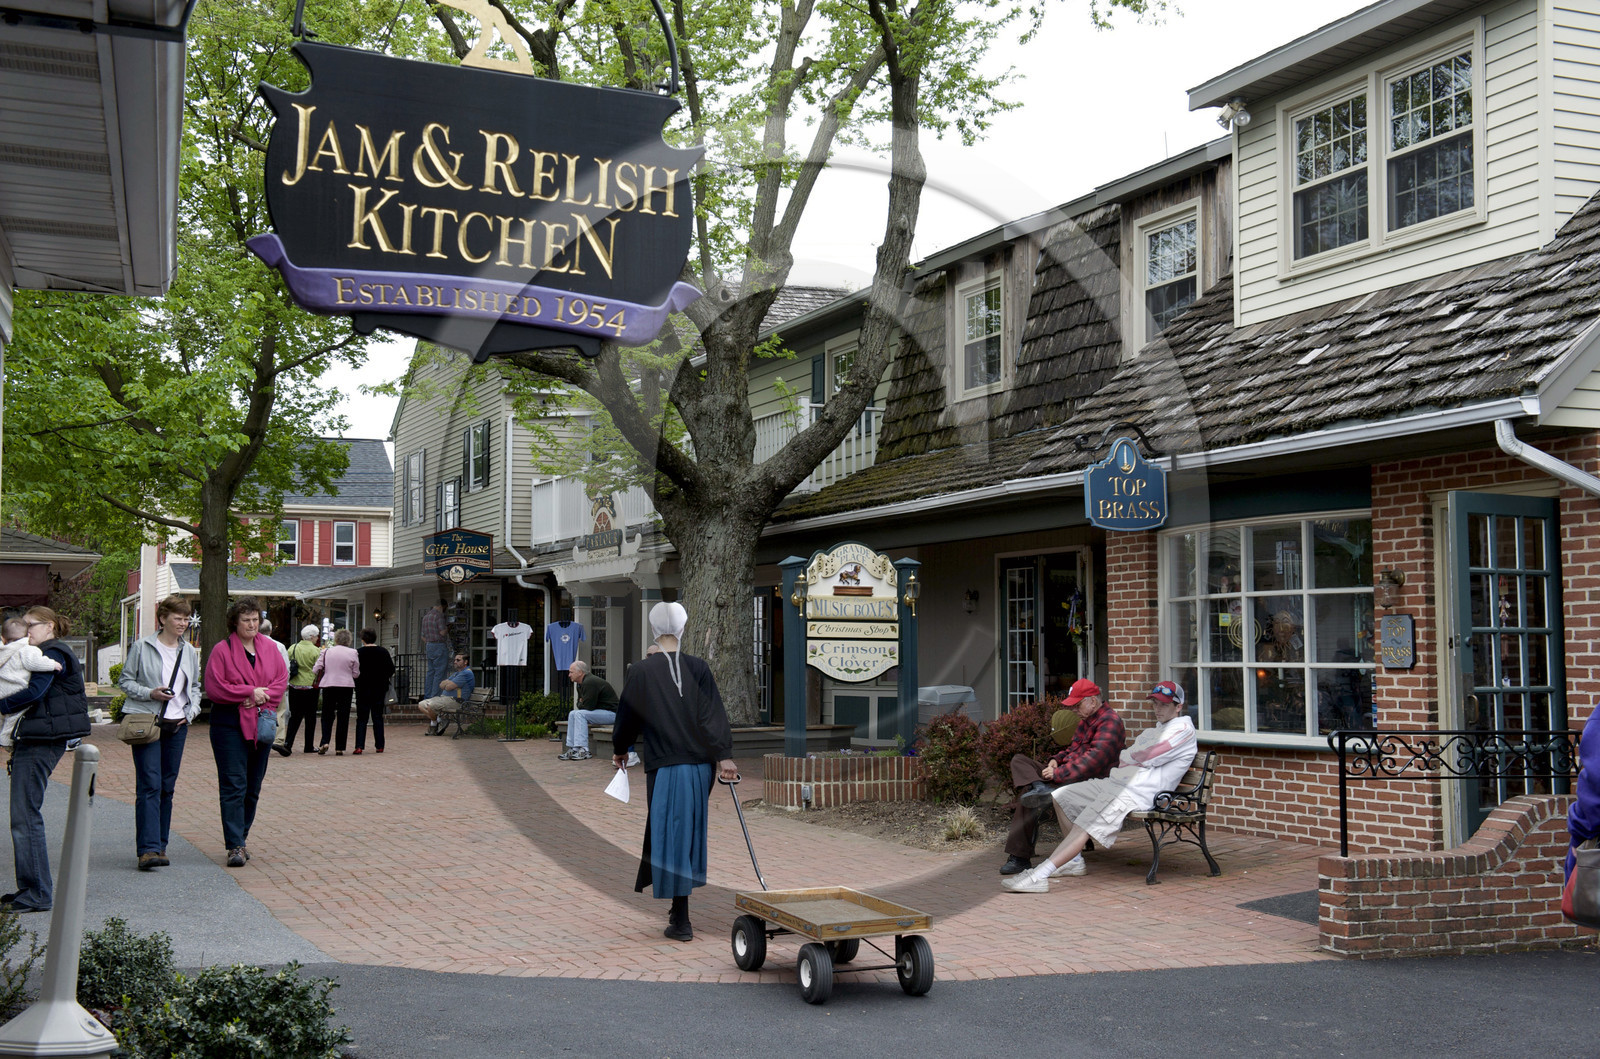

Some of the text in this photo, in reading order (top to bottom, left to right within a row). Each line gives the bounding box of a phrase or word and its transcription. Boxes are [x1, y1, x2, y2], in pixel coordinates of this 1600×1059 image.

[282, 103, 680, 218] JAM & RELISH
[347, 183, 620, 280] KITCHEN
[332, 276, 628, 337] ESTABLISHED 1954
[1108, 476, 1147, 497] TOP
[1098, 499, 1160, 519] BRASS
[451, 533, 464, 541] The
[426, 543, 489, 556] Gift House
[836, 545, 871, 560] GRANDE
[840, 554, 868, 566] PLACE
[814, 598, 893, 618] MUSIC BOXES
[817, 623, 889, 636] Christmas Shop
[1385, 626, 1406, 637] TOP
[820, 642, 887, 654] Crimson
[1382, 646, 1411, 657] BRASS
[828, 656, 879, 668] Clover
